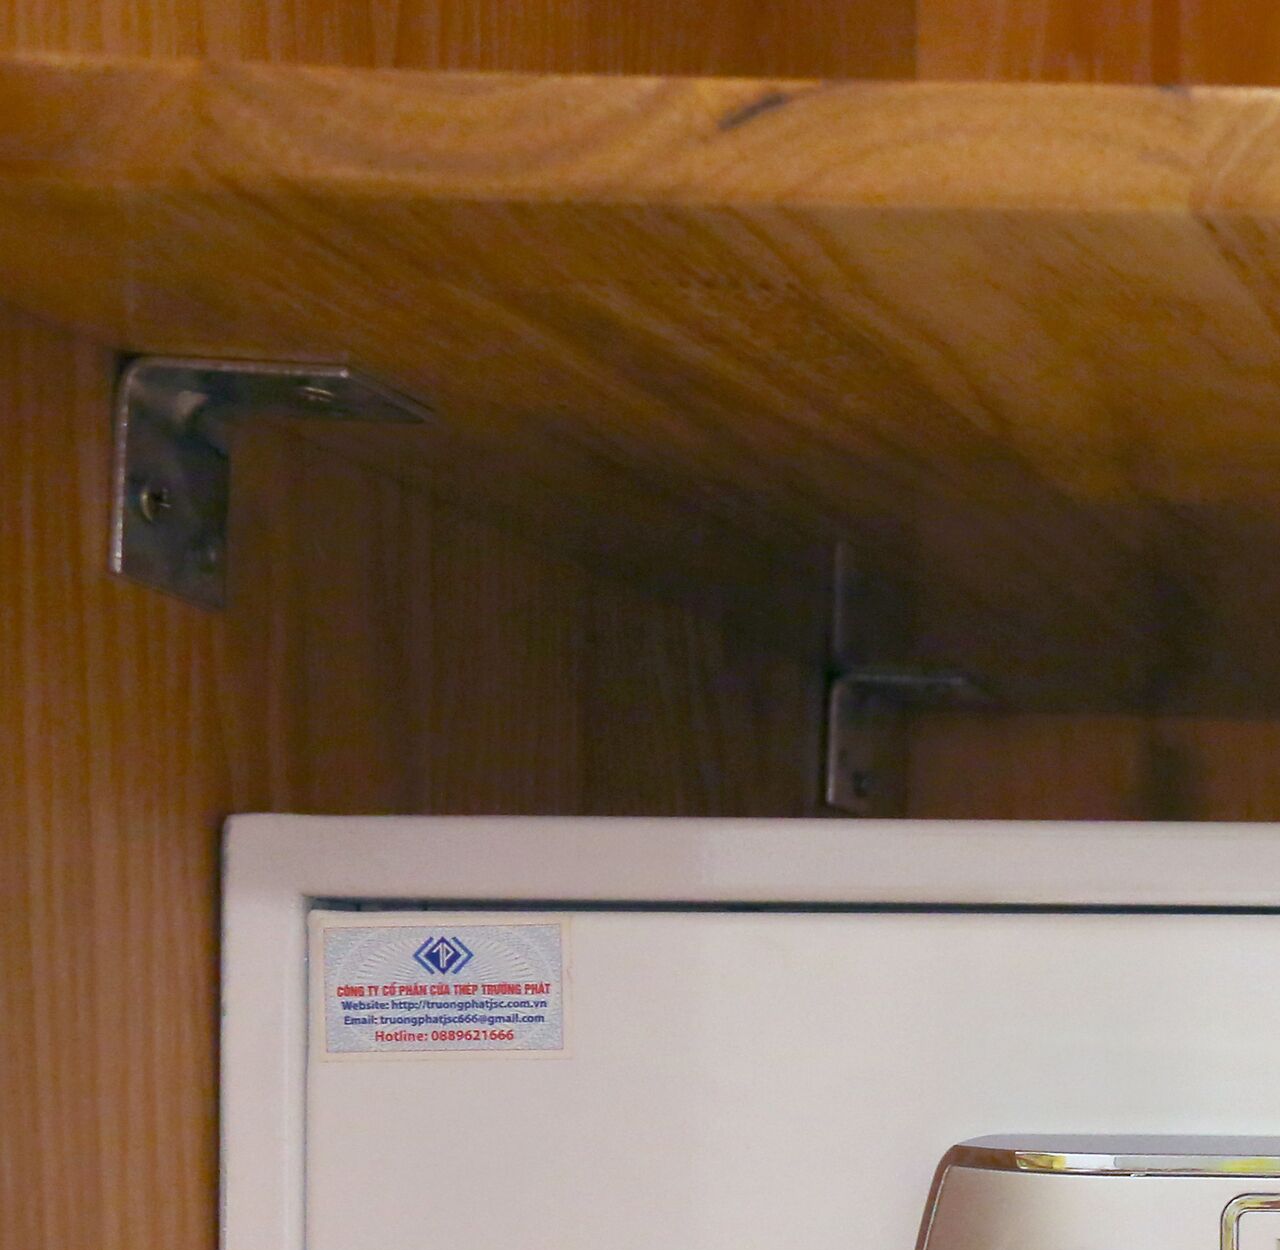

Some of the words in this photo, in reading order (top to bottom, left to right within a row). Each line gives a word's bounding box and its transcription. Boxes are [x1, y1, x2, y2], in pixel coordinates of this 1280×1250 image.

[342, 1000, 389, 1010] Website:
[344, 1015, 377, 1025] Email:
[375, 1030, 428, 1042] Hotline:
[431, 1030, 514, 1041] 0889621666
